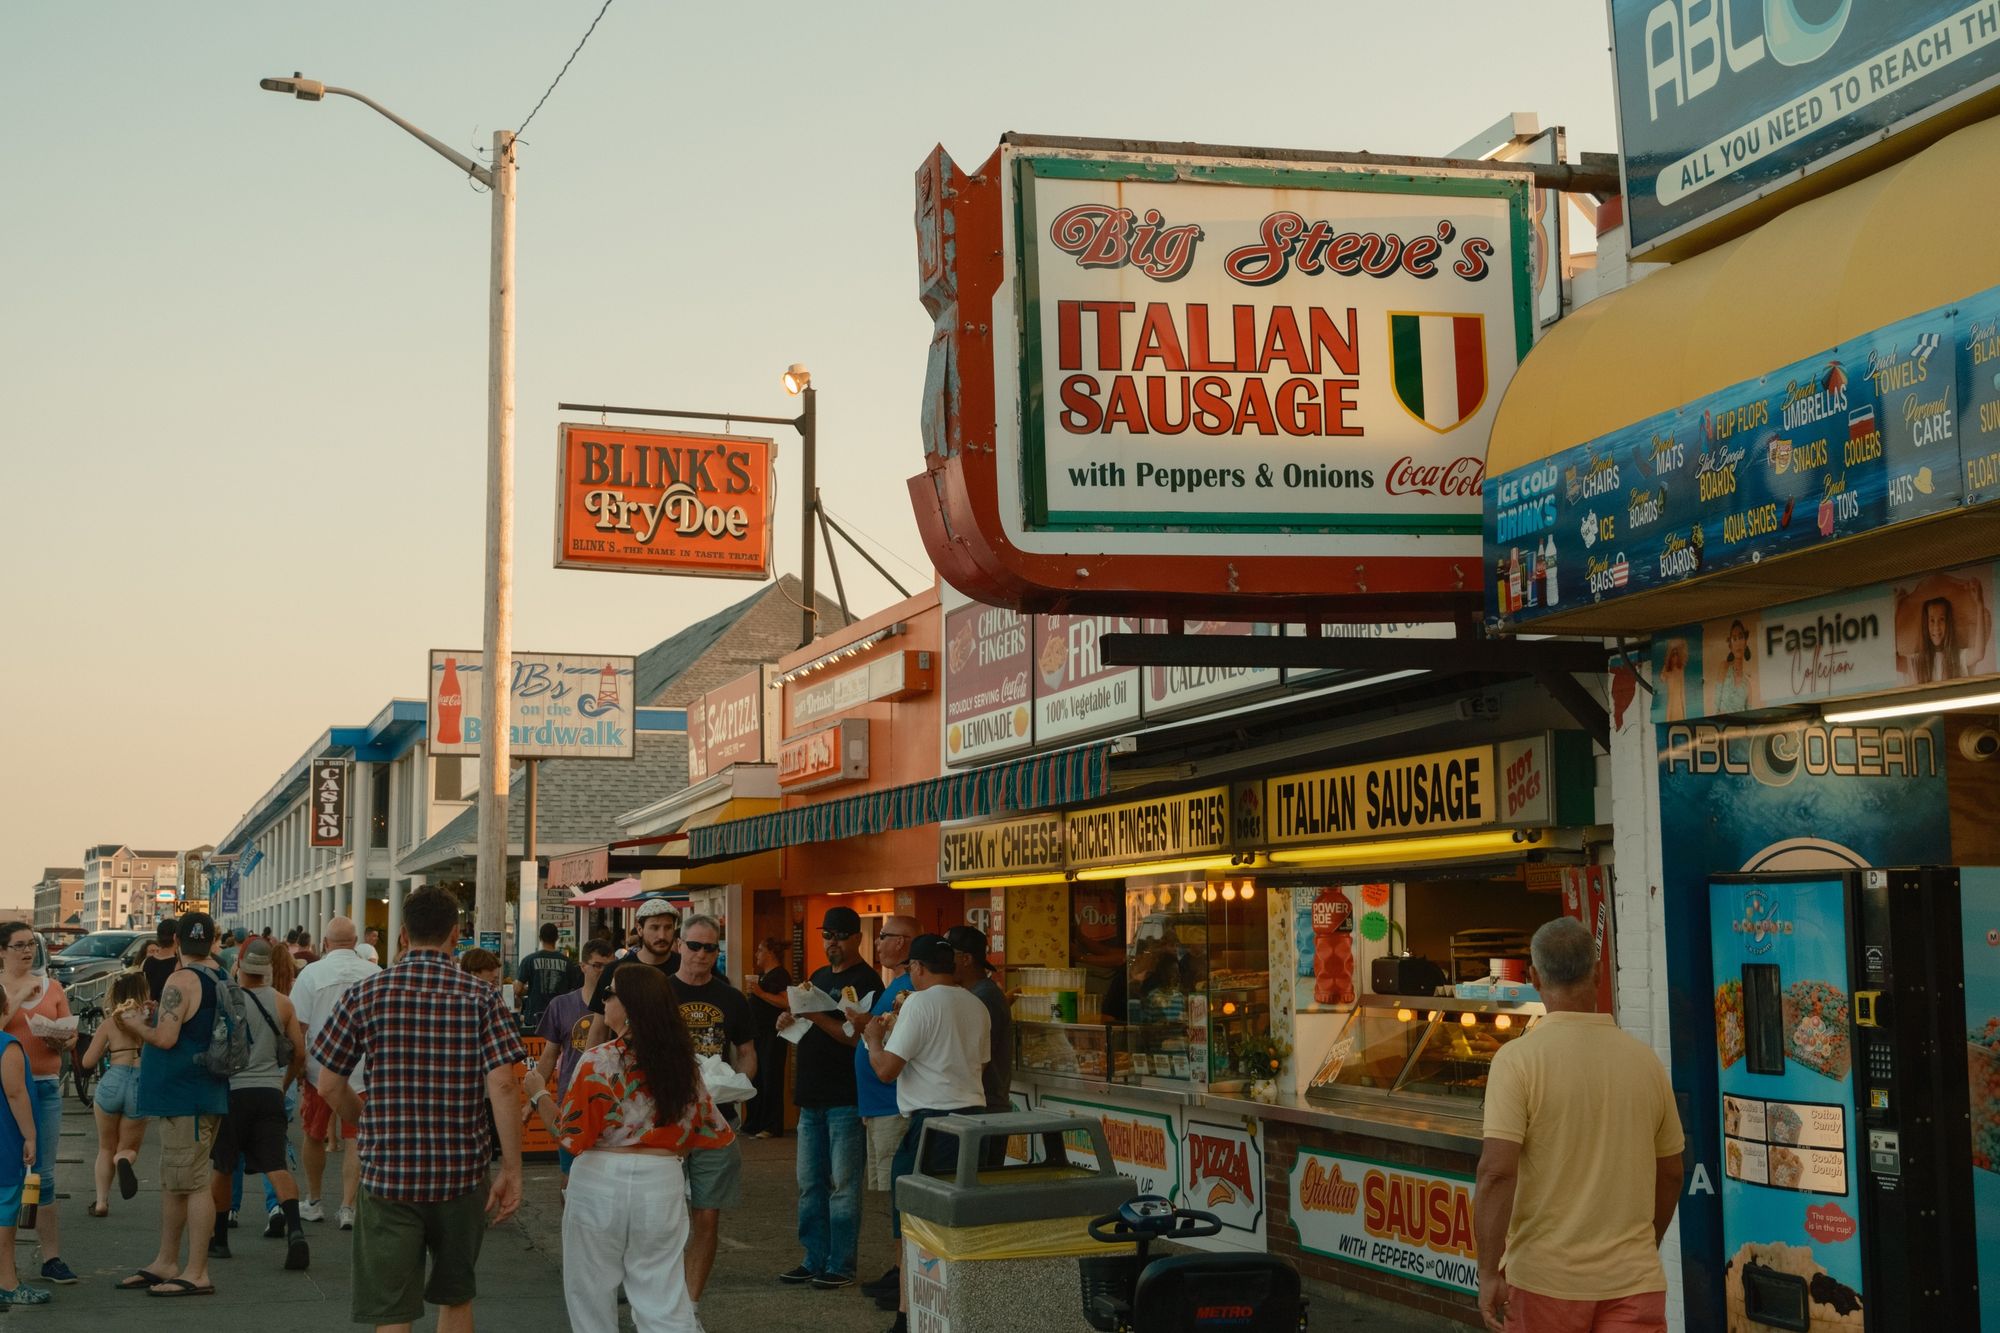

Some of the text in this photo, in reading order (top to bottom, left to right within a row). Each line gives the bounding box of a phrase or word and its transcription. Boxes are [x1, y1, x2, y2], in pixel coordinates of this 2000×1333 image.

[1680, 3, 2000, 190] ALL YOU NEED TO REACH TH
[1050, 203, 1494, 286] Big Steve's
[1058, 300, 1360, 375] ITALIAN
[1966, 317, 1995, 351] Beach
[1864, 344, 1896, 382] Beach
[1872, 355, 1927, 397] TOWELS
[1059, 374, 1364, 437] SAUSAGE
[1781, 374, 1816, 411] Beach
[1783, 384, 1847, 431] UMBRELLAS
[1903, 385, 1950, 430] Personal
[1716, 400, 1768, 440] FLIP FLOPS
[1913, 410, 1952, 447] CARE
[1648, 431, 1675, 462] Beach
[1656, 443, 1684, 476] MATS
[1714, 445, 1745, 473] Boogie
[1793, 438, 1828, 474] SNACKS
[1844, 431, 1882, 468] COOLERS
[580, 441, 750, 493] BLINK'S
[1068, 462, 1375, 493] with Peppers & Onions
[1497, 464, 1558, 507] ICE COLD
[1583, 452, 1614, 482] Beach
[1583, 465, 1620, 499] CHAIRS
[1700, 465, 1736, 502] BOARDS
[1967, 453, 2000, 491] FLOAT
[1821, 472, 1846, 504] Beach
[1837, 490, 1859, 521] TOYS
[1888, 474, 1913, 507] HATS
[584, 482, 749, 543] Fry Doe
[1497, 495, 1557, 544] DRINKS
[1600, 515, 1615, 541] ICE
[1630, 499, 1658, 529] BOARDS
[1724, 503, 1777, 544] AQUA SHOES
[623, 546, 643, 554] THE
[647, 548, 676, 556] NAME
[695, 550, 725, 560] TASTE
[1660, 546, 1696, 578] BOARDS
[1661, 532, 1686, 559] Skim
[1585, 553, 1609, 580] Beach
[1590, 566, 1614, 594] BAGS
[979, 626, 1026, 667] FINGERS
[1765, 611, 1879, 656] Fashion
[1790, 644, 1855, 697] Collection
[520, 702, 572, 716] on the
[949, 671, 1027, 716] PROUDLY SERVING Coca-Cola
[1046, 680, 1127, 724] 100% Vegetable Oil
[463, 716, 626, 747] Bardwalk
[708, 700, 728, 749] Sal's
[727, 693, 758, 744] PIZZA
[963, 712, 1013, 750] LEMONADE
[1506, 748, 1533, 790] HOT
[1668, 725, 1937, 777] ABC OCEAN
[318, 768, 340, 838] CASINO
[1277, 757, 1482, 837] ITALIAN SAUSAGE
[1506, 771, 1542, 817] DOGS
[1070, 794, 1225, 862] CHICKEN FINGERS W/ FRIES
[1237, 815, 1261, 840] DOGS
[943, 830, 984, 873] STEAK
[1001, 821, 1058, 868] CHEESE
[1313, 902, 1349, 914] POWER
[1810, 1109, 1841, 1121] Cotton
[1812, 1121, 1841, 1134] Candy
[1132, 1121, 1167, 1171] CAESAR
[1811, 1153, 1842, 1165] Cookie
[1140, 1179, 1154, 1193] UP
[1188, 1133, 1254, 1206] PIZZA
[1302, 1158, 1357, 1213] Italian
[1811, 1165, 1842, 1179] Dough
[1808, 1222, 1852, 1235] is in the cup!
[1812, 1212, 1848, 1225] The spoon
[1338, 1233, 1368, 1258] WITH
[1371, 1242, 1425, 1274] PEPPERS
[1426, 1260, 1435, 1270] AND
[913, 1272, 950, 1317] HAMPTON
[1194, 1306, 1254, 1319] METRO
